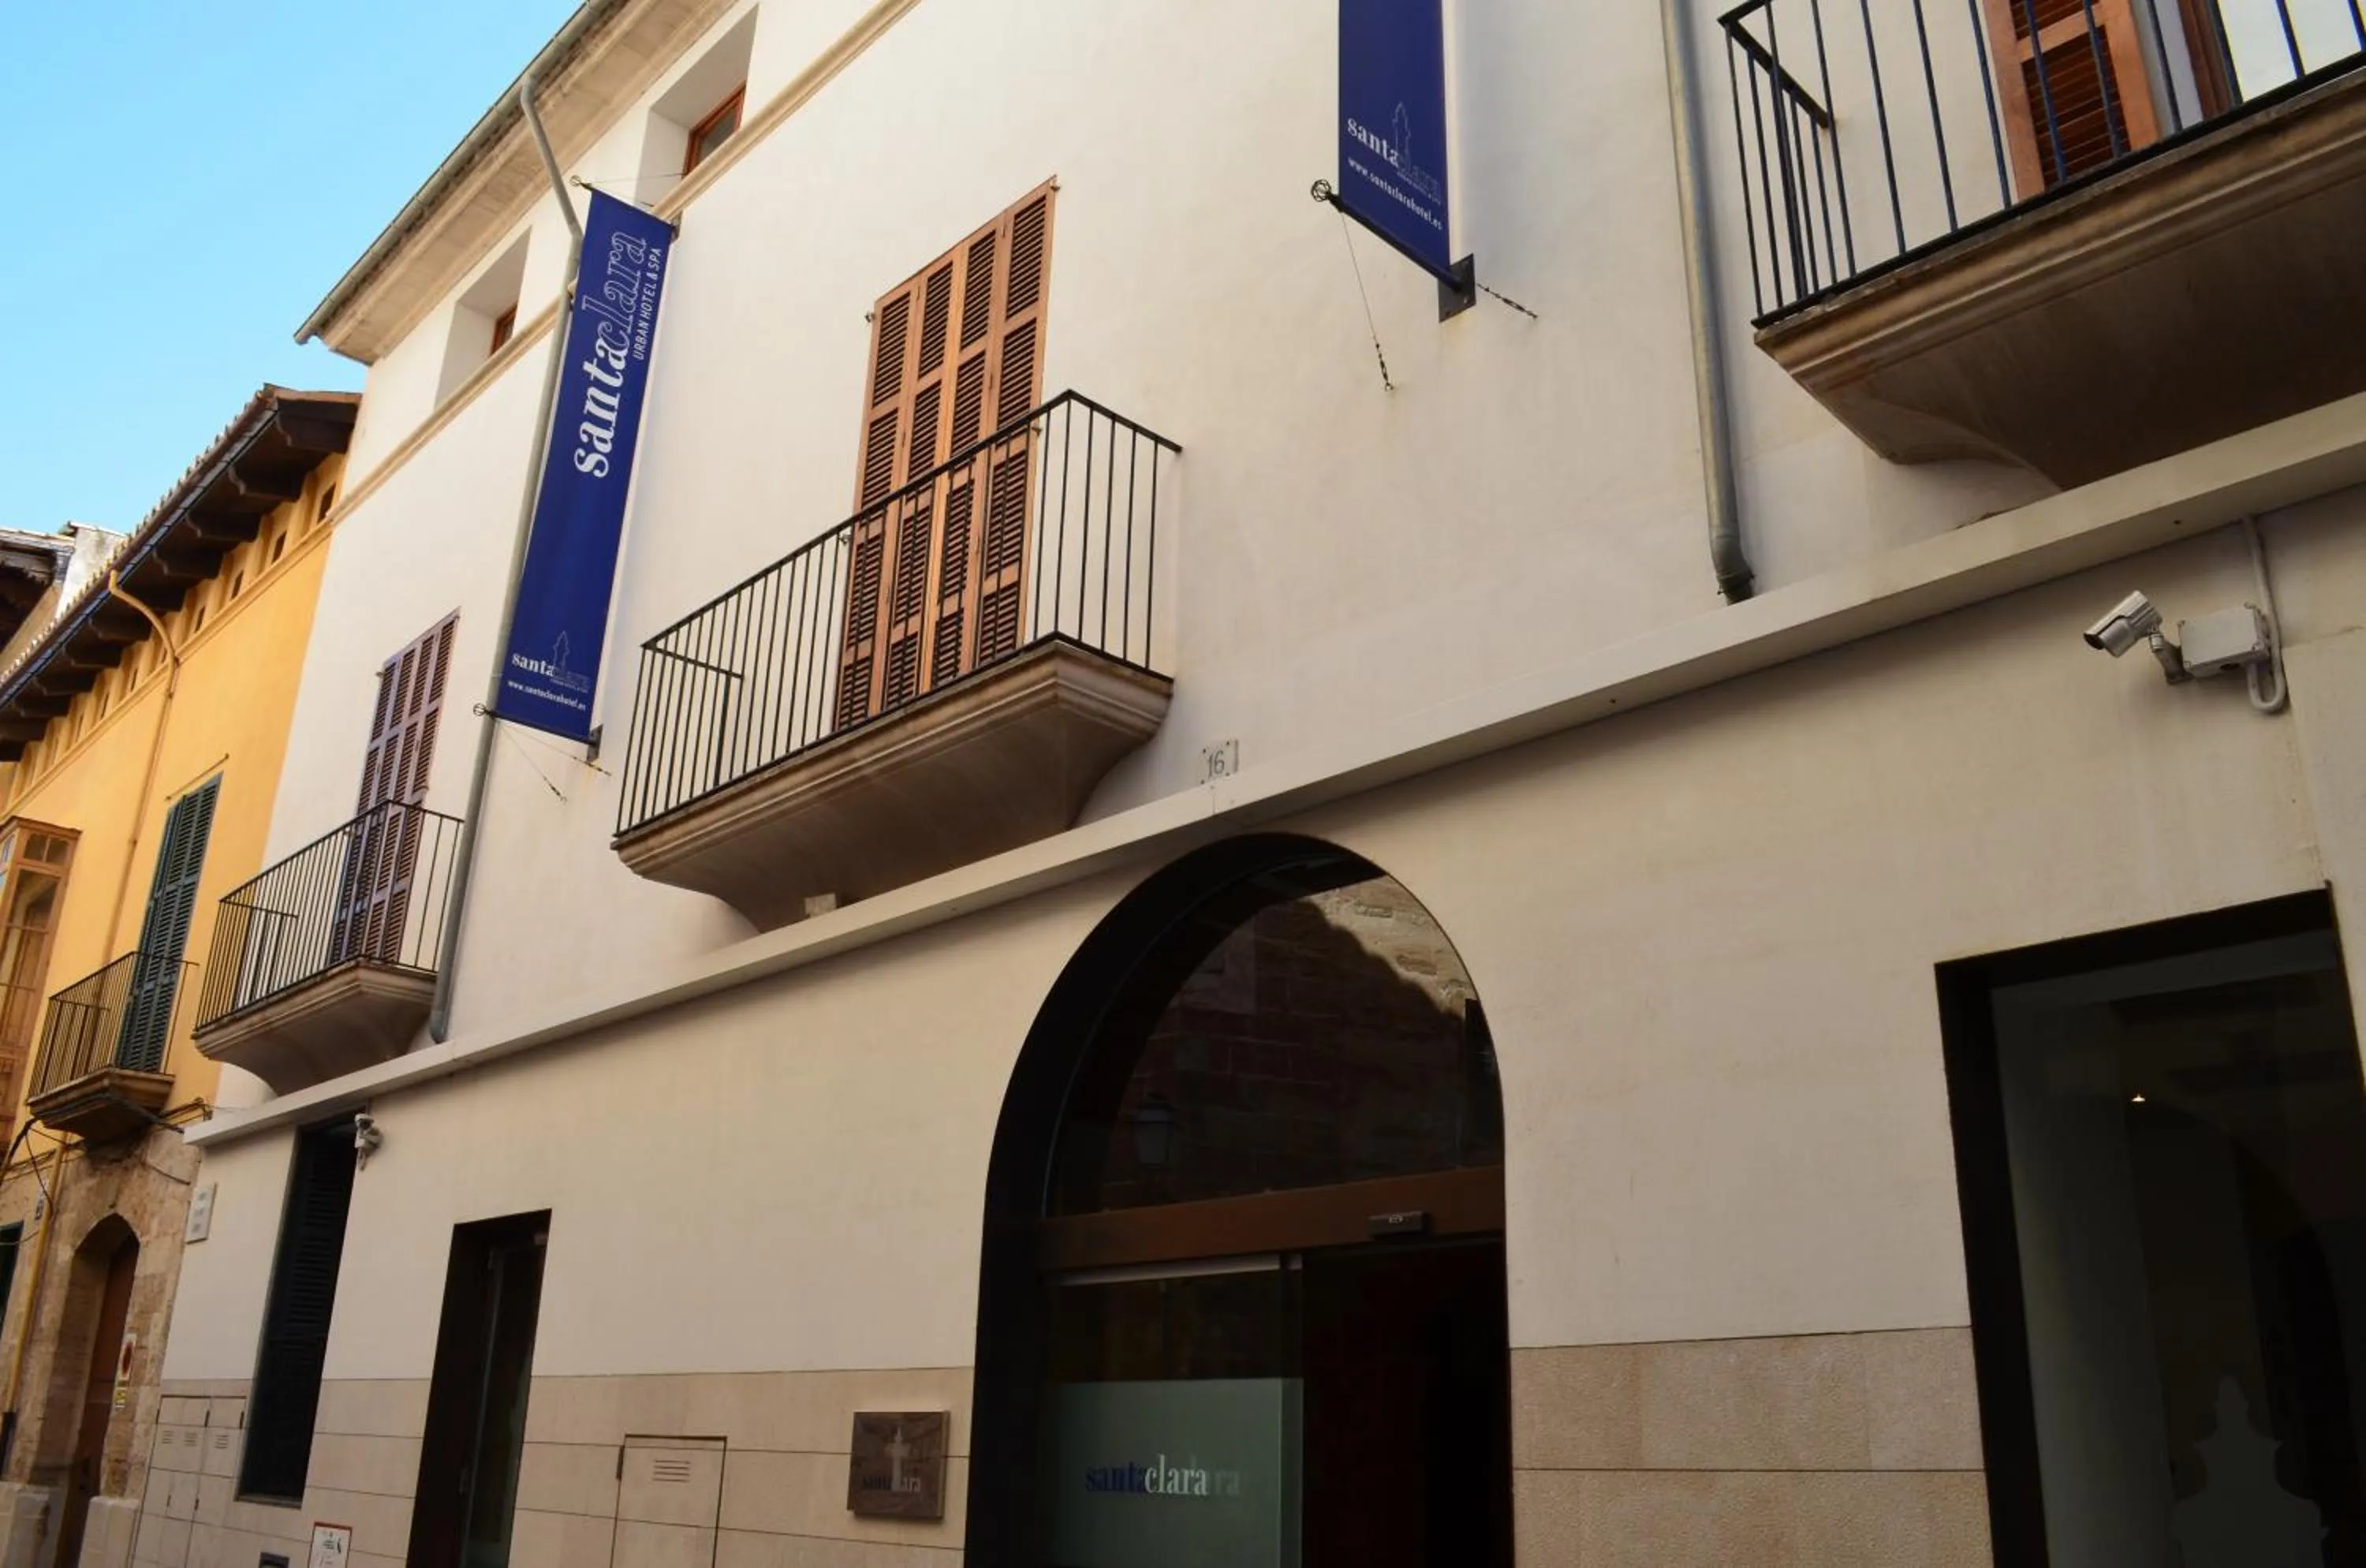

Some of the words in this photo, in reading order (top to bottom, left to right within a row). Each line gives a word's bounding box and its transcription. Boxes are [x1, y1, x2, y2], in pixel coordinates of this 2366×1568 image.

[648, 248, 662, 271] SPA
[640, 283, 657, 319] HOTEL
[633, 319, 649, 360] URBAN
